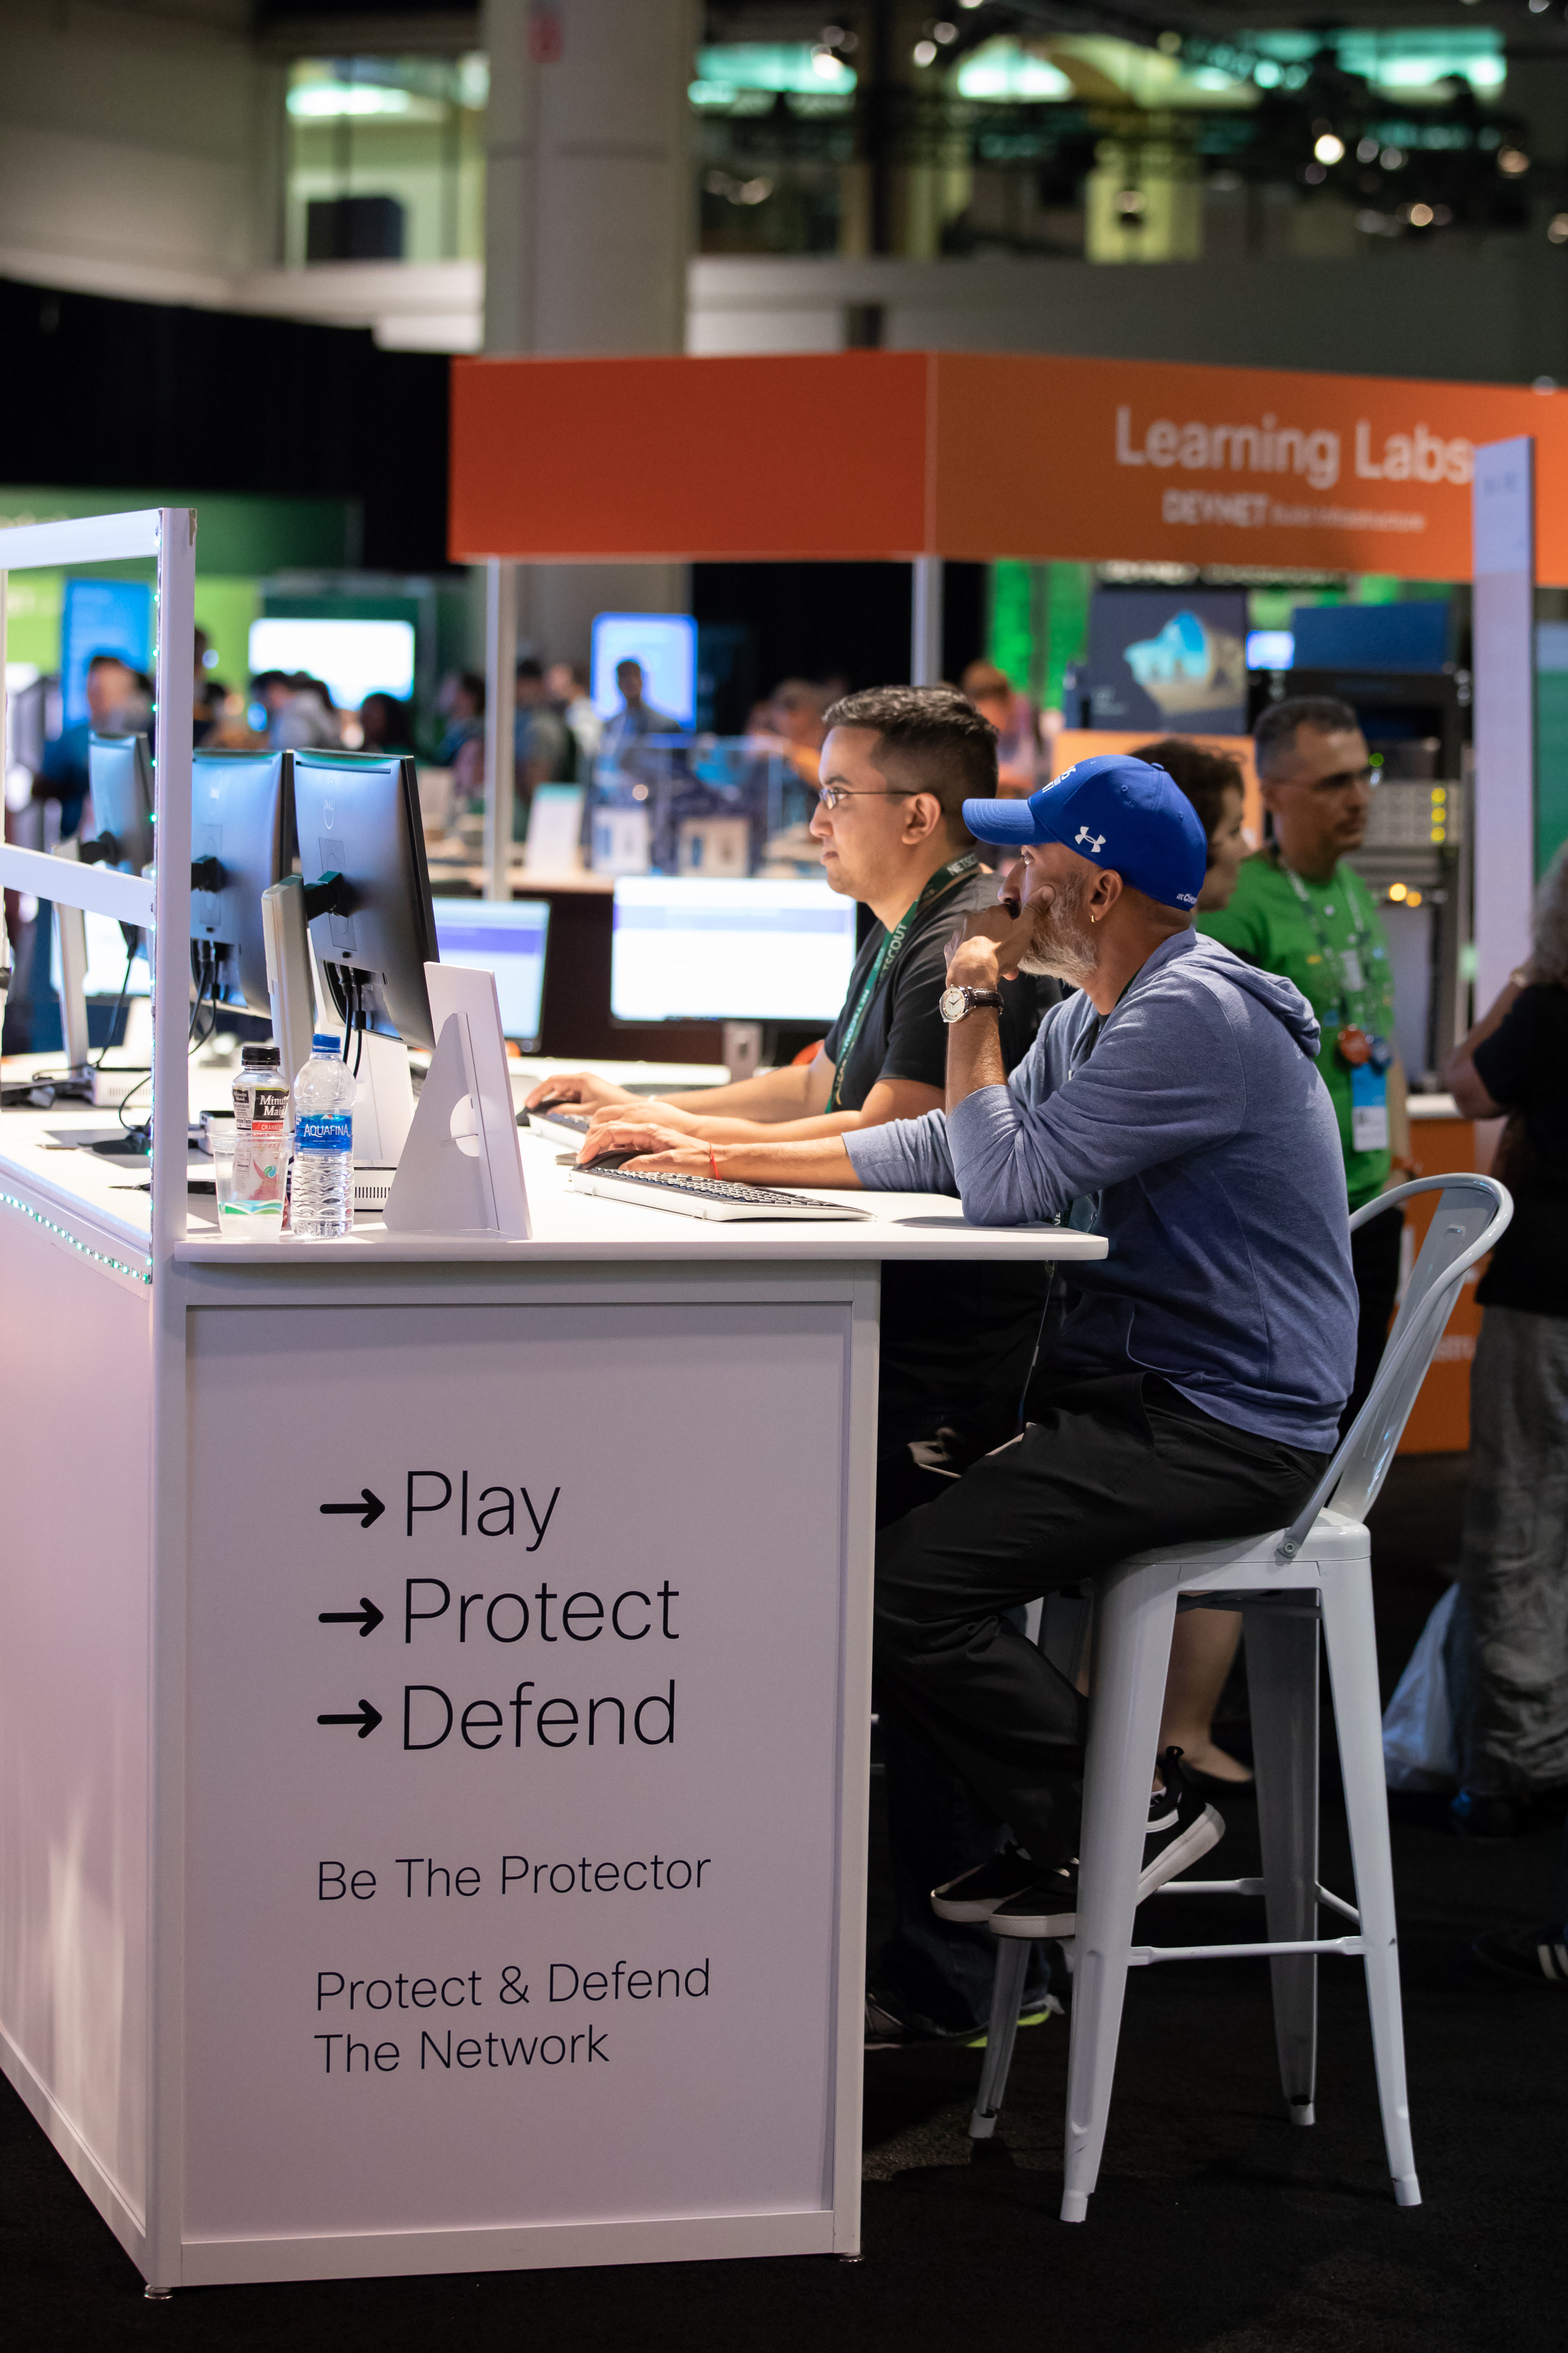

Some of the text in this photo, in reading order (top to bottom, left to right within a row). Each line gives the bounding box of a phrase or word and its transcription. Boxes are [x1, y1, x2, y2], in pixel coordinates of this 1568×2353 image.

[1116, 405, 1475, 489] Learning Labs
[304, 1124, 350, 1138] AQUAFINA
[407, 1470, 561, 1552] Play
[405, 1579, 679, 1643] Protect
[404, 1679, 675, 1750] Defend
[319, 1855, 711, 1900] Be The Protector
[318, 1958, 709, 2011] Protect & Defend
[314, 2024, 610, 2073] The Network
